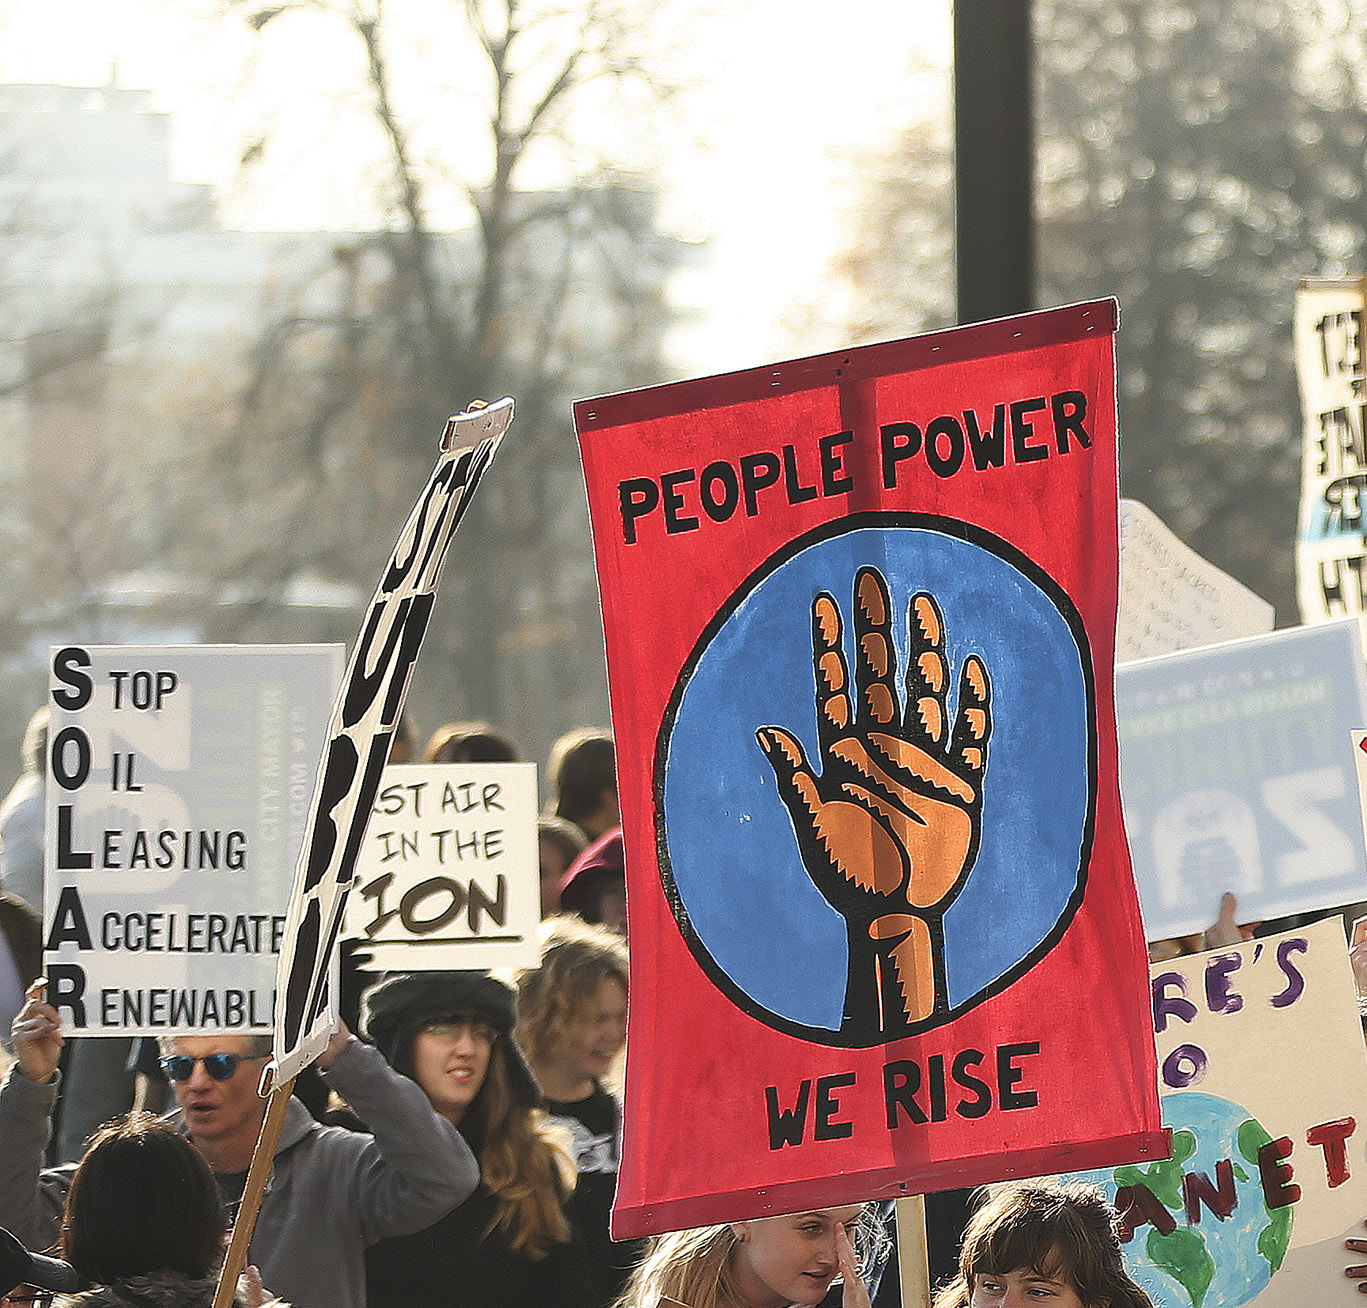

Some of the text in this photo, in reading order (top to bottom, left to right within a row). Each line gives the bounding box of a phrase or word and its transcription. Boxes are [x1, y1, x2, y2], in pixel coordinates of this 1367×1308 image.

[617, 389, 1095, 545] PEOPLE POWER
[377, 829, 506, 861] IN THE
[440, 781, 506, 813] AIR
[46, 964, 276, 1029] RENEWABL
[1152, 936, 1309, 1035] RE'S
[764, 1040, 1042, 1152] WE RISE
[1114, 1115, 1359, 1244] ANET
